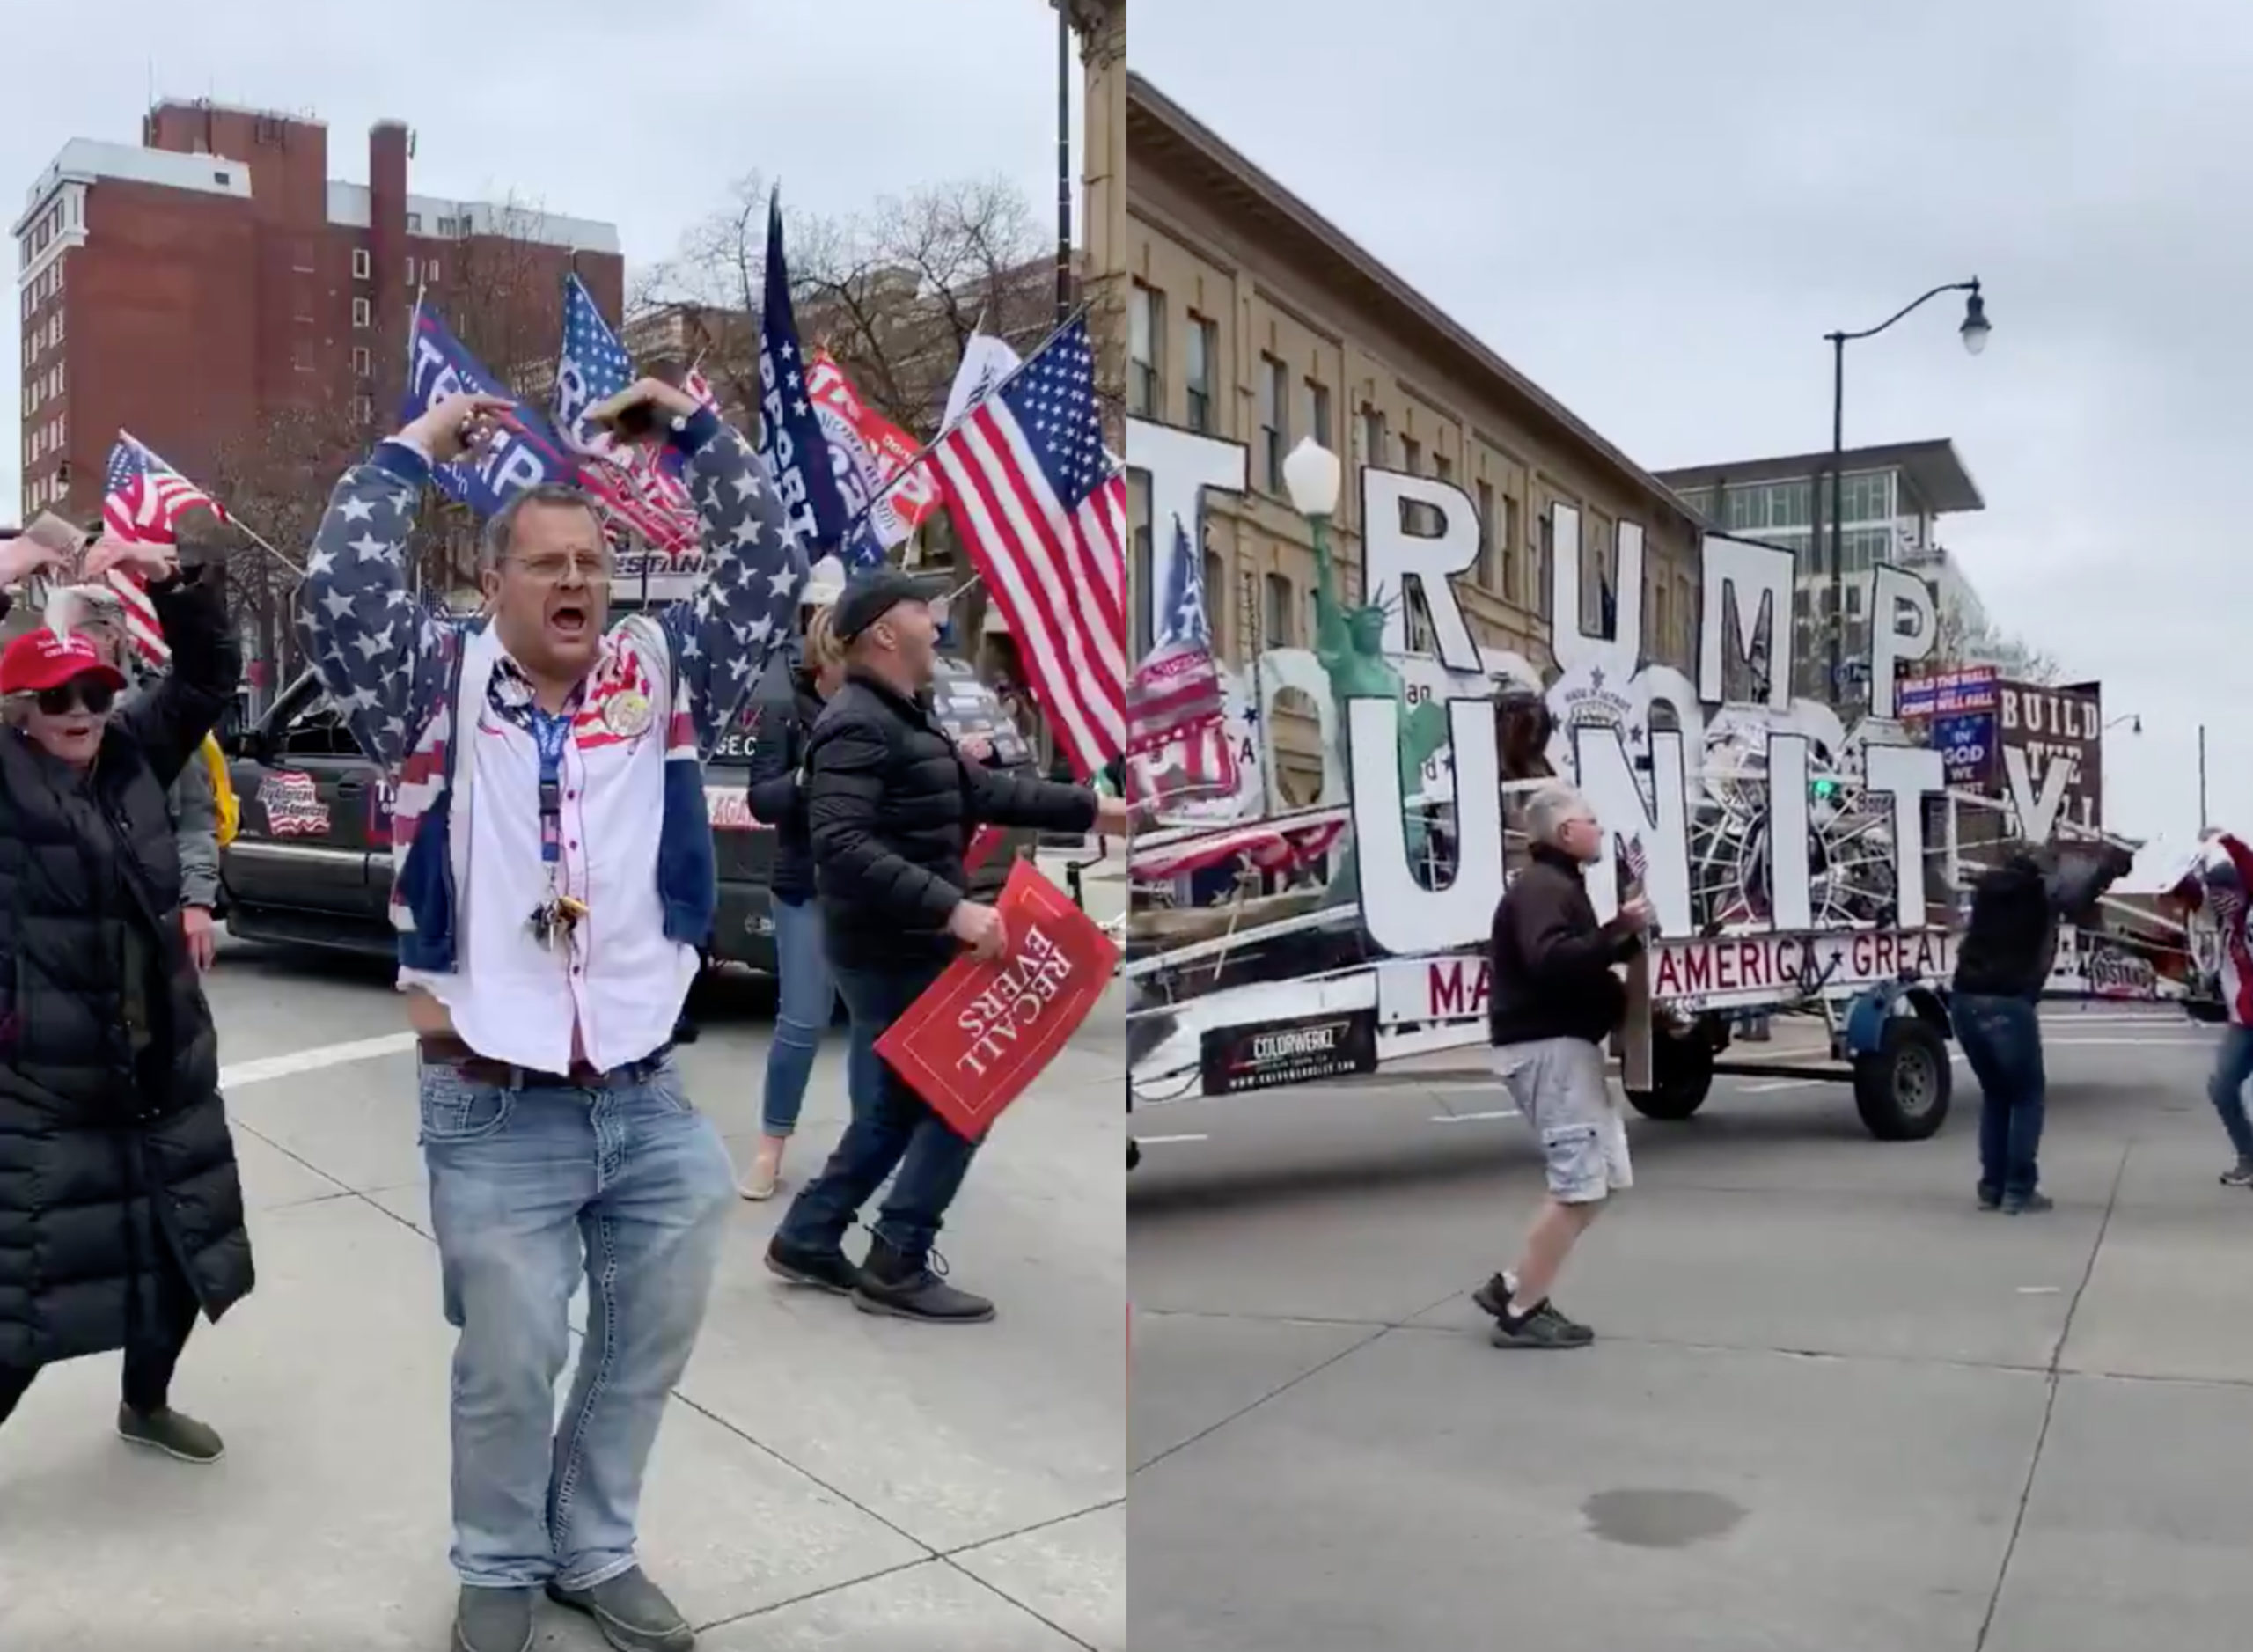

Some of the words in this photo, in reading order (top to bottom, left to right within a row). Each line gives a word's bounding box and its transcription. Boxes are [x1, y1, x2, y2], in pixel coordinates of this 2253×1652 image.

[415, 335, 545, 497] TRP
[1127, 417, 1938, 719] TRUMP
[1944, 745, 1985, 766] GOD
[2000, 689, 2100, 740] BUILD
[956, 944, 1074, 1077] RECALL
[958, 924, 1053, 1038] EVERS
[1655, 936, 1823, 995] AMERICA
[1852, 930, 1948, 977] GREAT
